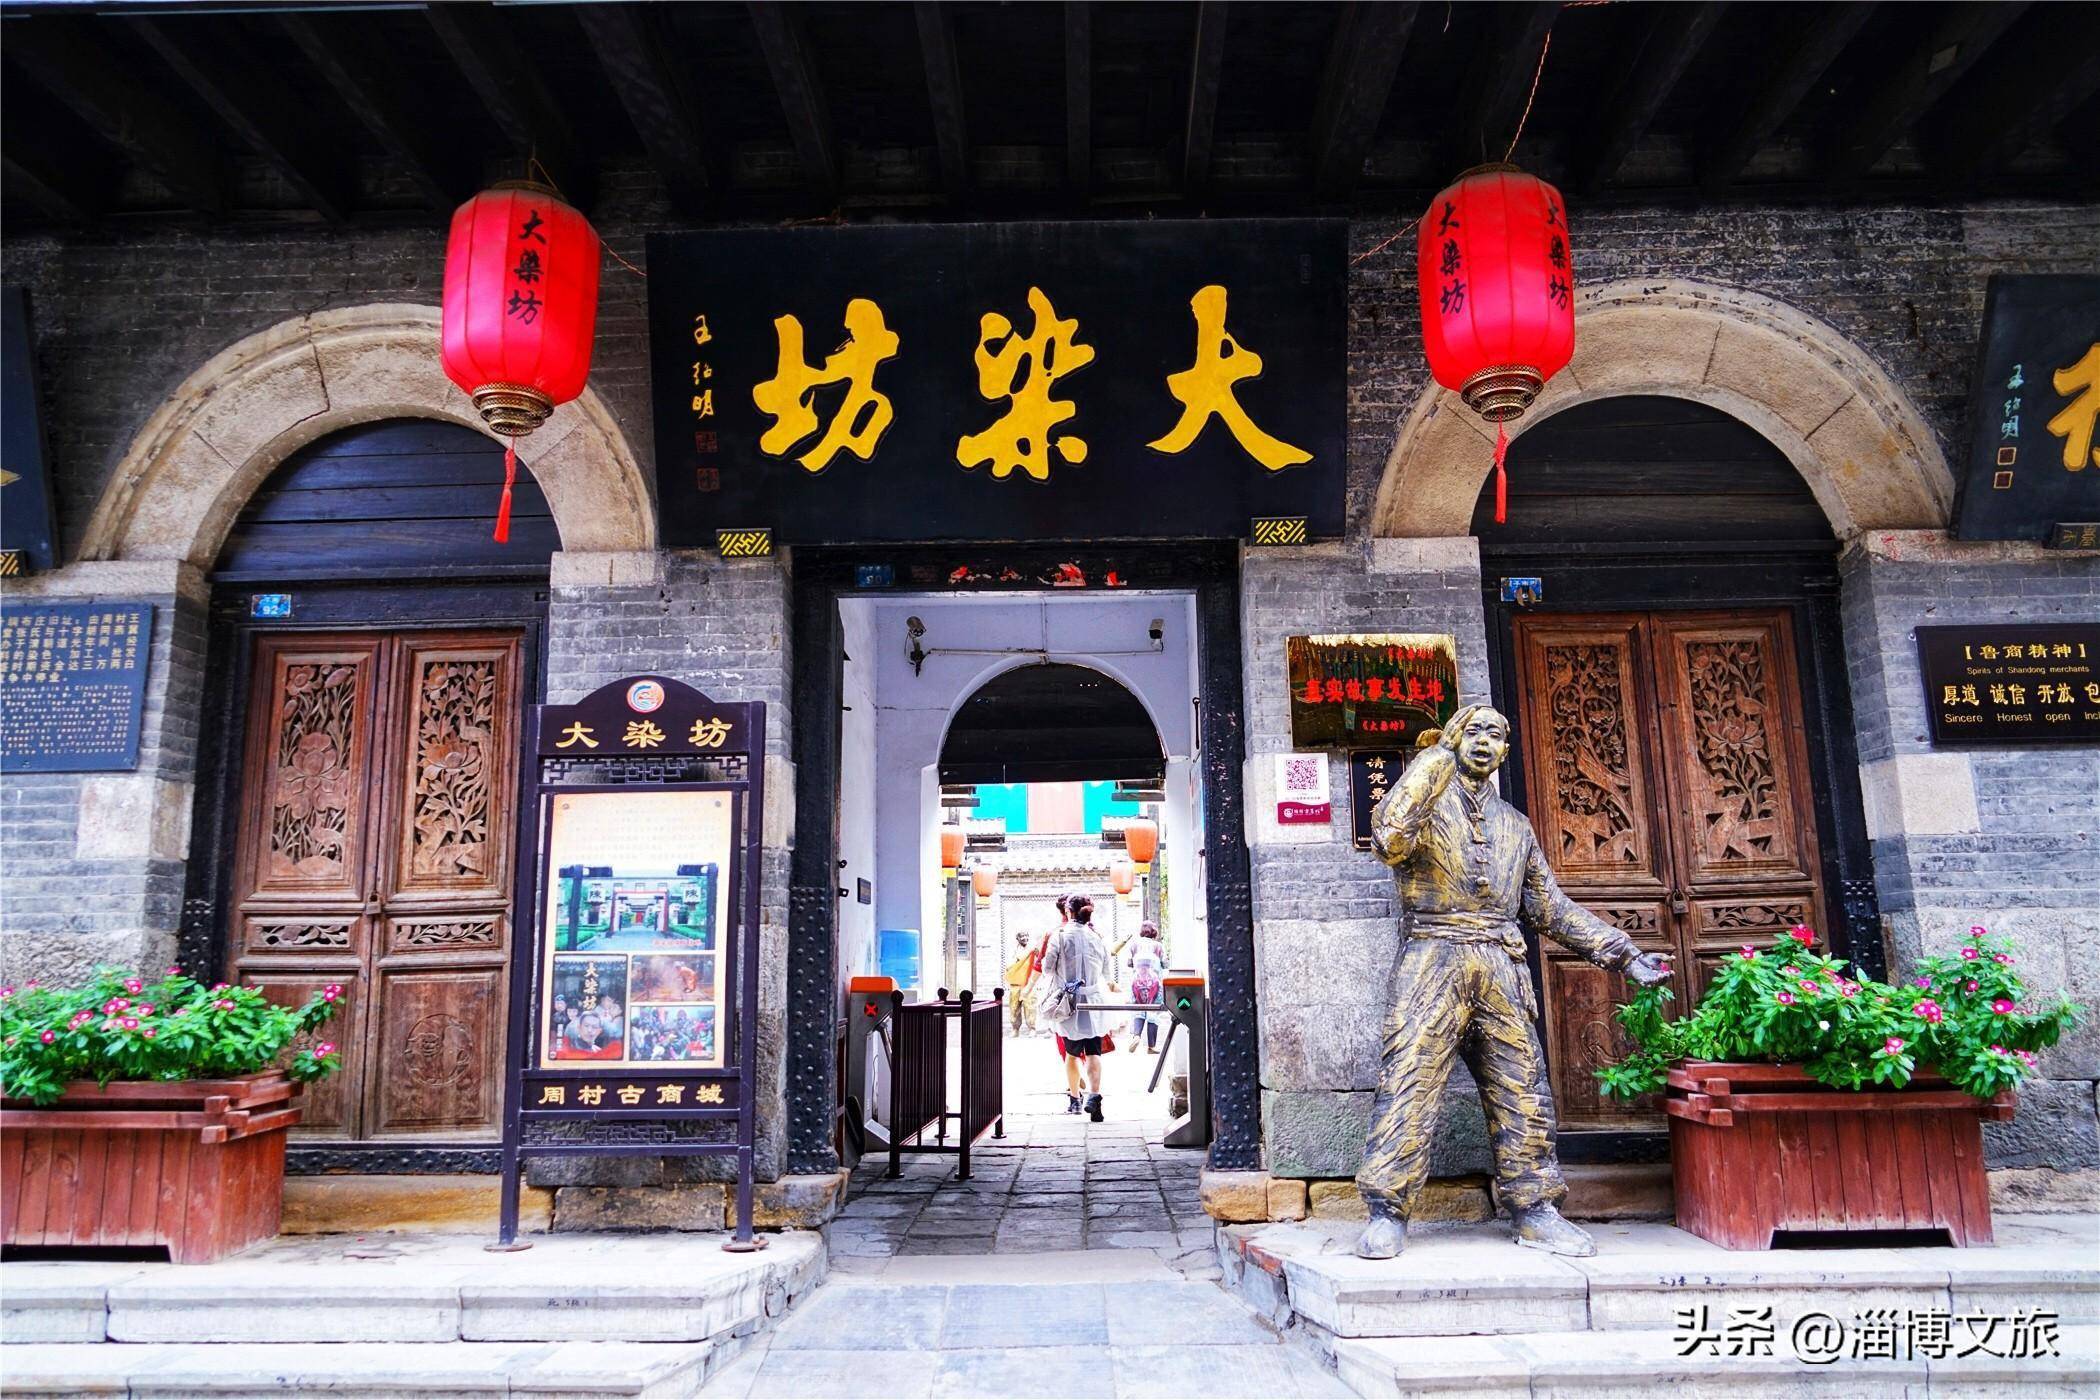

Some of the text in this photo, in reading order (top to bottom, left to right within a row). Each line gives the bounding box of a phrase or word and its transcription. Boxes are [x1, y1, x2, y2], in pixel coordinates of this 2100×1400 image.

[753, 285, 1314, 479] 大染坊
[1966, 667, 1991, 675] Spirits
[2007, 666, 2046, 675] Shandong
[2050, 665, 2090, 673] merchants
[1943, 683, 1980, 706] 厚道
[1990, 683, 2026, 705] 诚信
[2037, 682, 2075, 704] 开放
[1944, 713, 1983, 723] Sincere
[1997, 712, 2033, 722] Honest
[2045, 712, 2071, 723] open
[555, 717, 733, 748] 大染坊
[1365, 756, 1388, 812] 请凭票
[538, 1084, 725, 1105] 周村古商城
